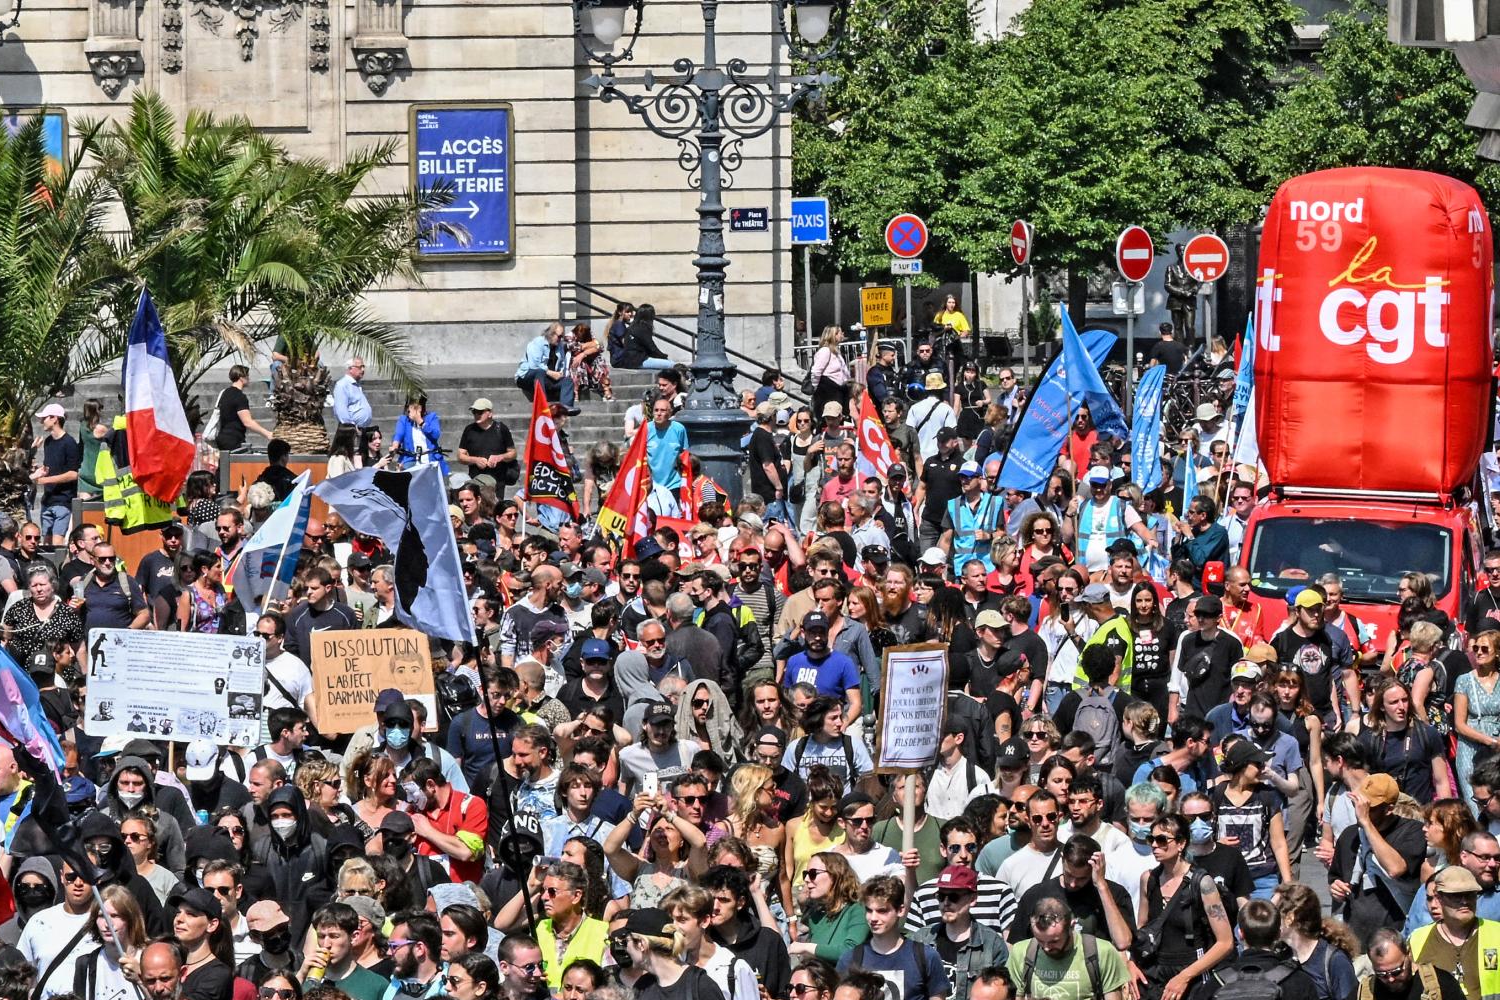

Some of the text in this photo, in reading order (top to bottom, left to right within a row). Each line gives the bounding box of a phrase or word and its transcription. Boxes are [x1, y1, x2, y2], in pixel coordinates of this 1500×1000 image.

[440, 136, 503, 155] ACCÈS
[418, 159, 477, 174] BILLET
[455, 177, 504, 192] TERIE
[1289, 198, 1364, 223] nord
[792, 214, 824, 228] TAXIS
[1295, 221, 1343, 253] 59
[1318, 276, 1451, 365] cgt
[323, 638, 419, 658] DISSOLUTION
[344, 658, 360, 672] DE
